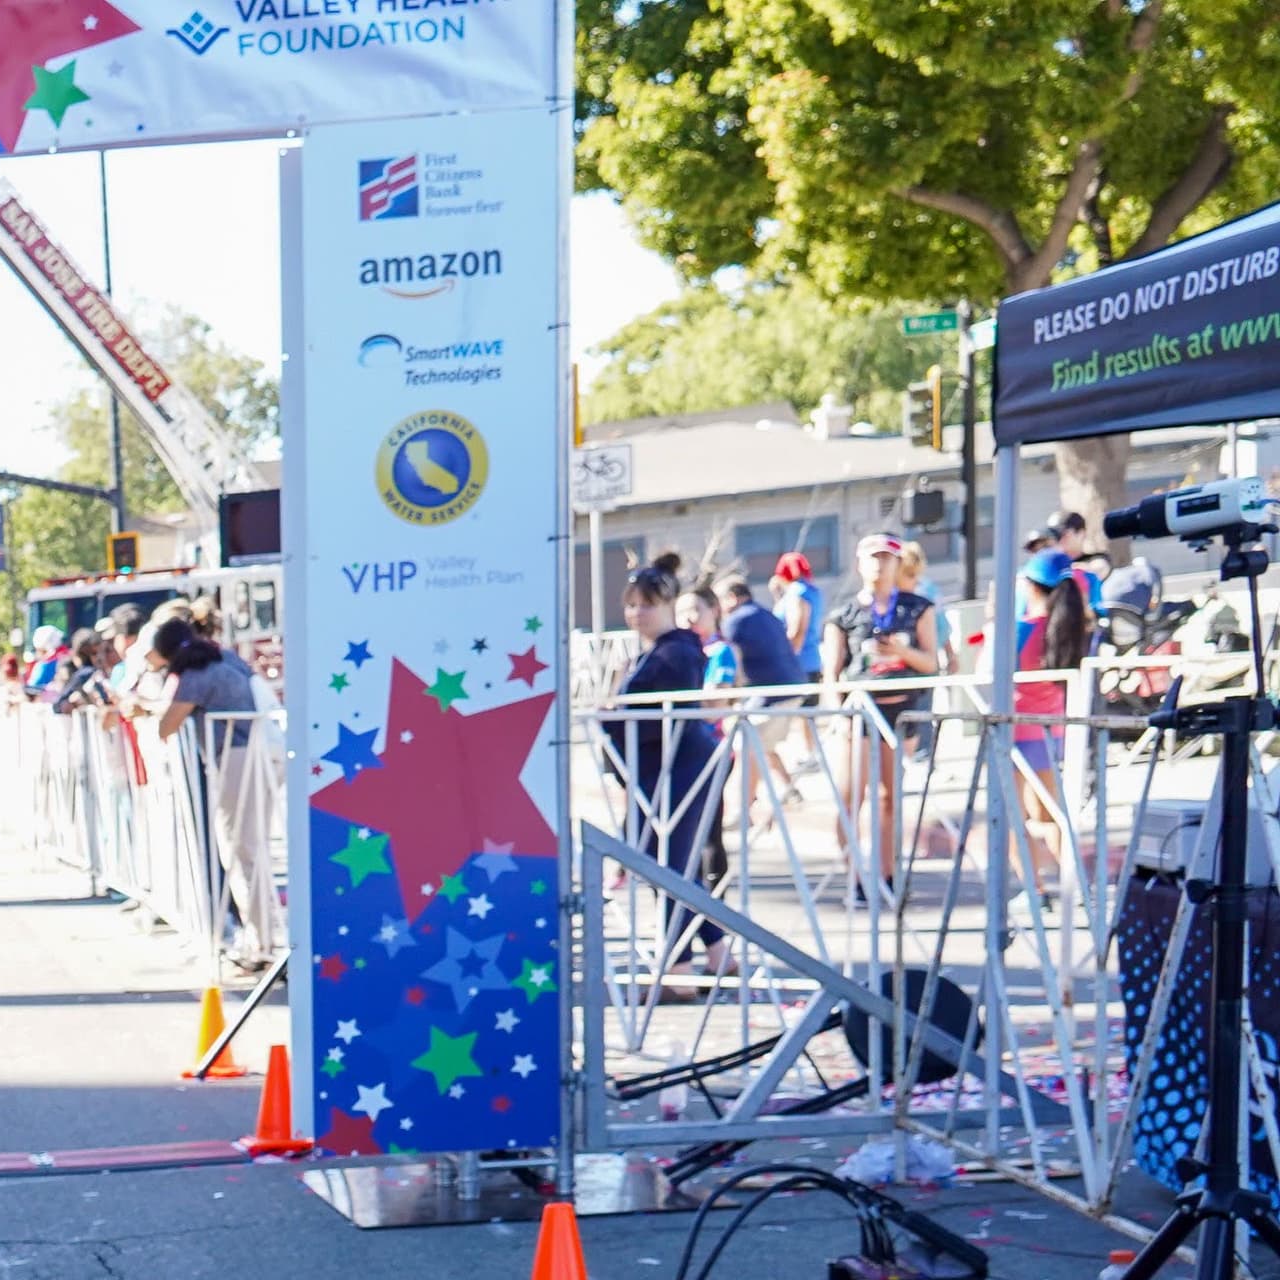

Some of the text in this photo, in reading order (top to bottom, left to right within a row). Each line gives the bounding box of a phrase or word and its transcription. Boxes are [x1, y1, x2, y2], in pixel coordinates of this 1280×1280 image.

[236, 0, 358, 23] VALLEY
[238, 16, 464, 56] FOUNDATION
[425, 152, 457, 166] First
[425, 184, 461, 199] Bank
[359, 249, 502, 284] amazon
[1033, 246, 1280, 344] PLEASE DO NOT DISTURB
[404, 339, 504, 362] SmartWAVE
[1050, 351, 1099, 393] Find
[1104, 334, 1182, 381] results
[1187, 324, 1214, 360] at
[404, 365, 502, 386] Technologies
[388, 414, 474, 447] CALIFORNIA
[385, 480, 481, 521] WATER SERVICE
[341, 561, 417, 595] VHP
[425, 556, 478, 572] Valley
[425, 569, 525, 589] Health Plan
